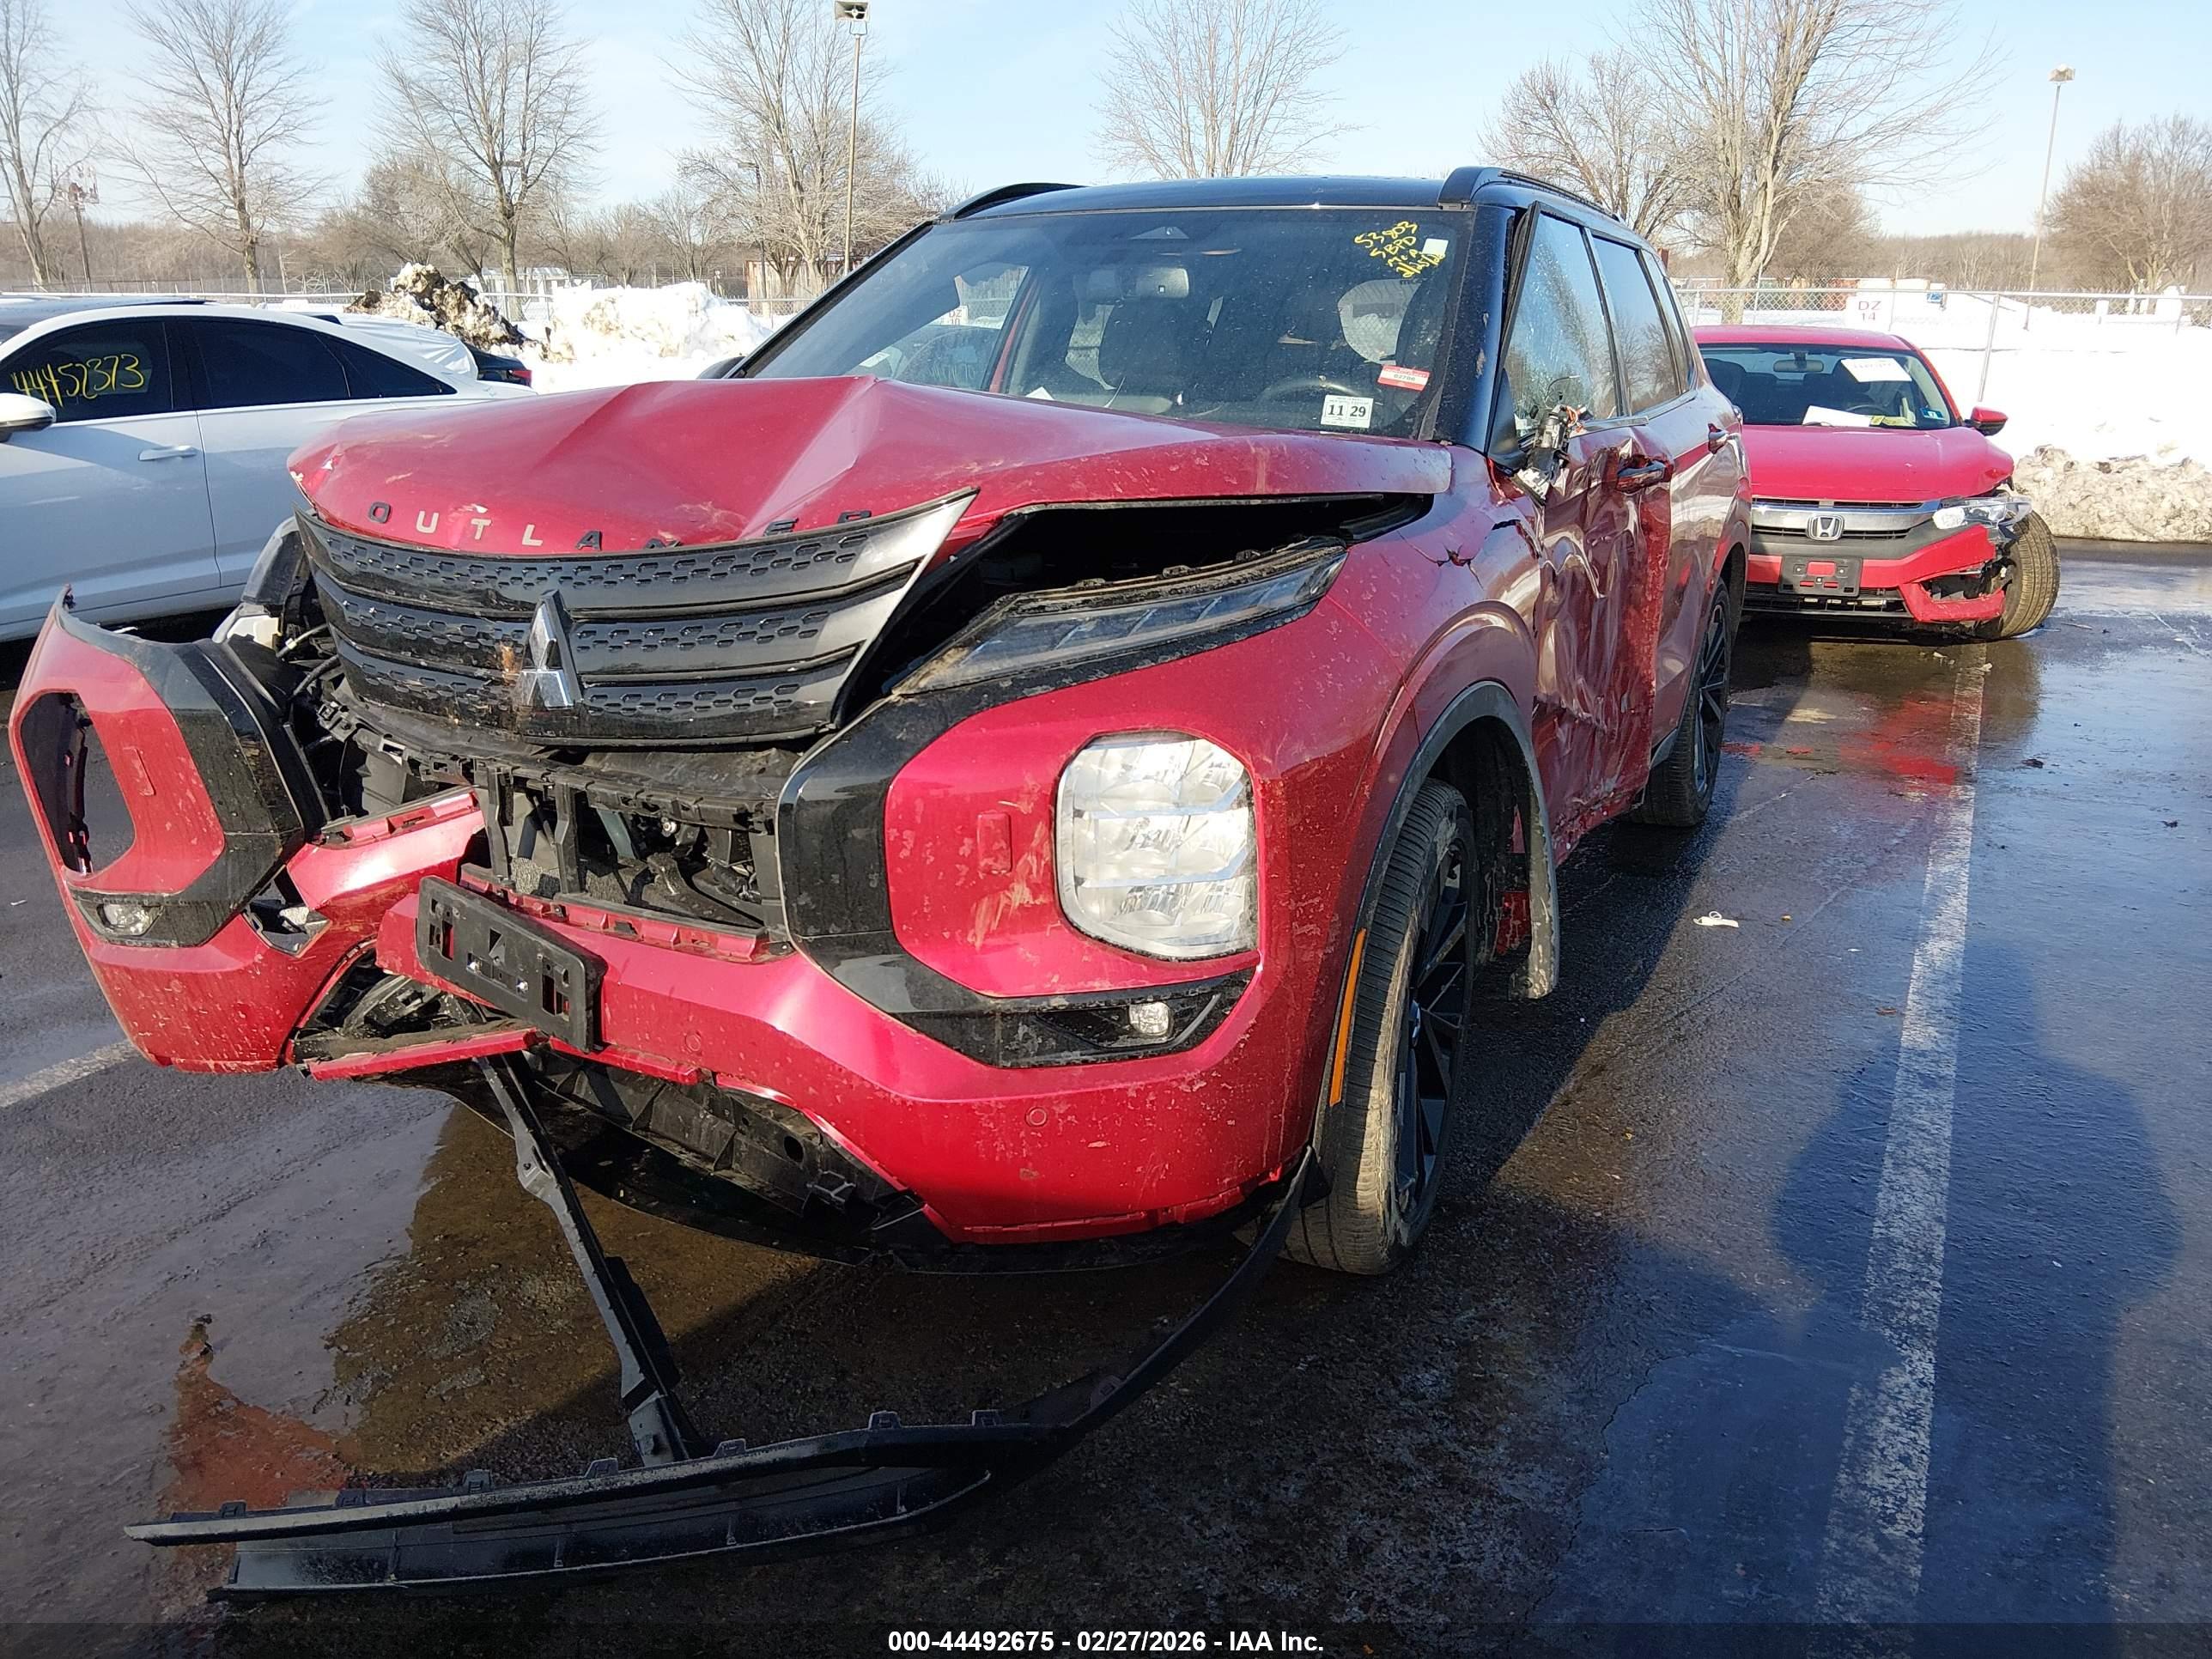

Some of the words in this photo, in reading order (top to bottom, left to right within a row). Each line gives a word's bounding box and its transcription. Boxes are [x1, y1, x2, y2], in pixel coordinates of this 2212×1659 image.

[1857, 301, 1882, 311] DZ
[1861, 312, 1876, 323] 14
[10, 354, 144, 407] 44452373
[1328, 404, 1344, 416] 11
[1349, 405, 1366, 417] 29
[368, 501, 872, 551] OUTLAE
